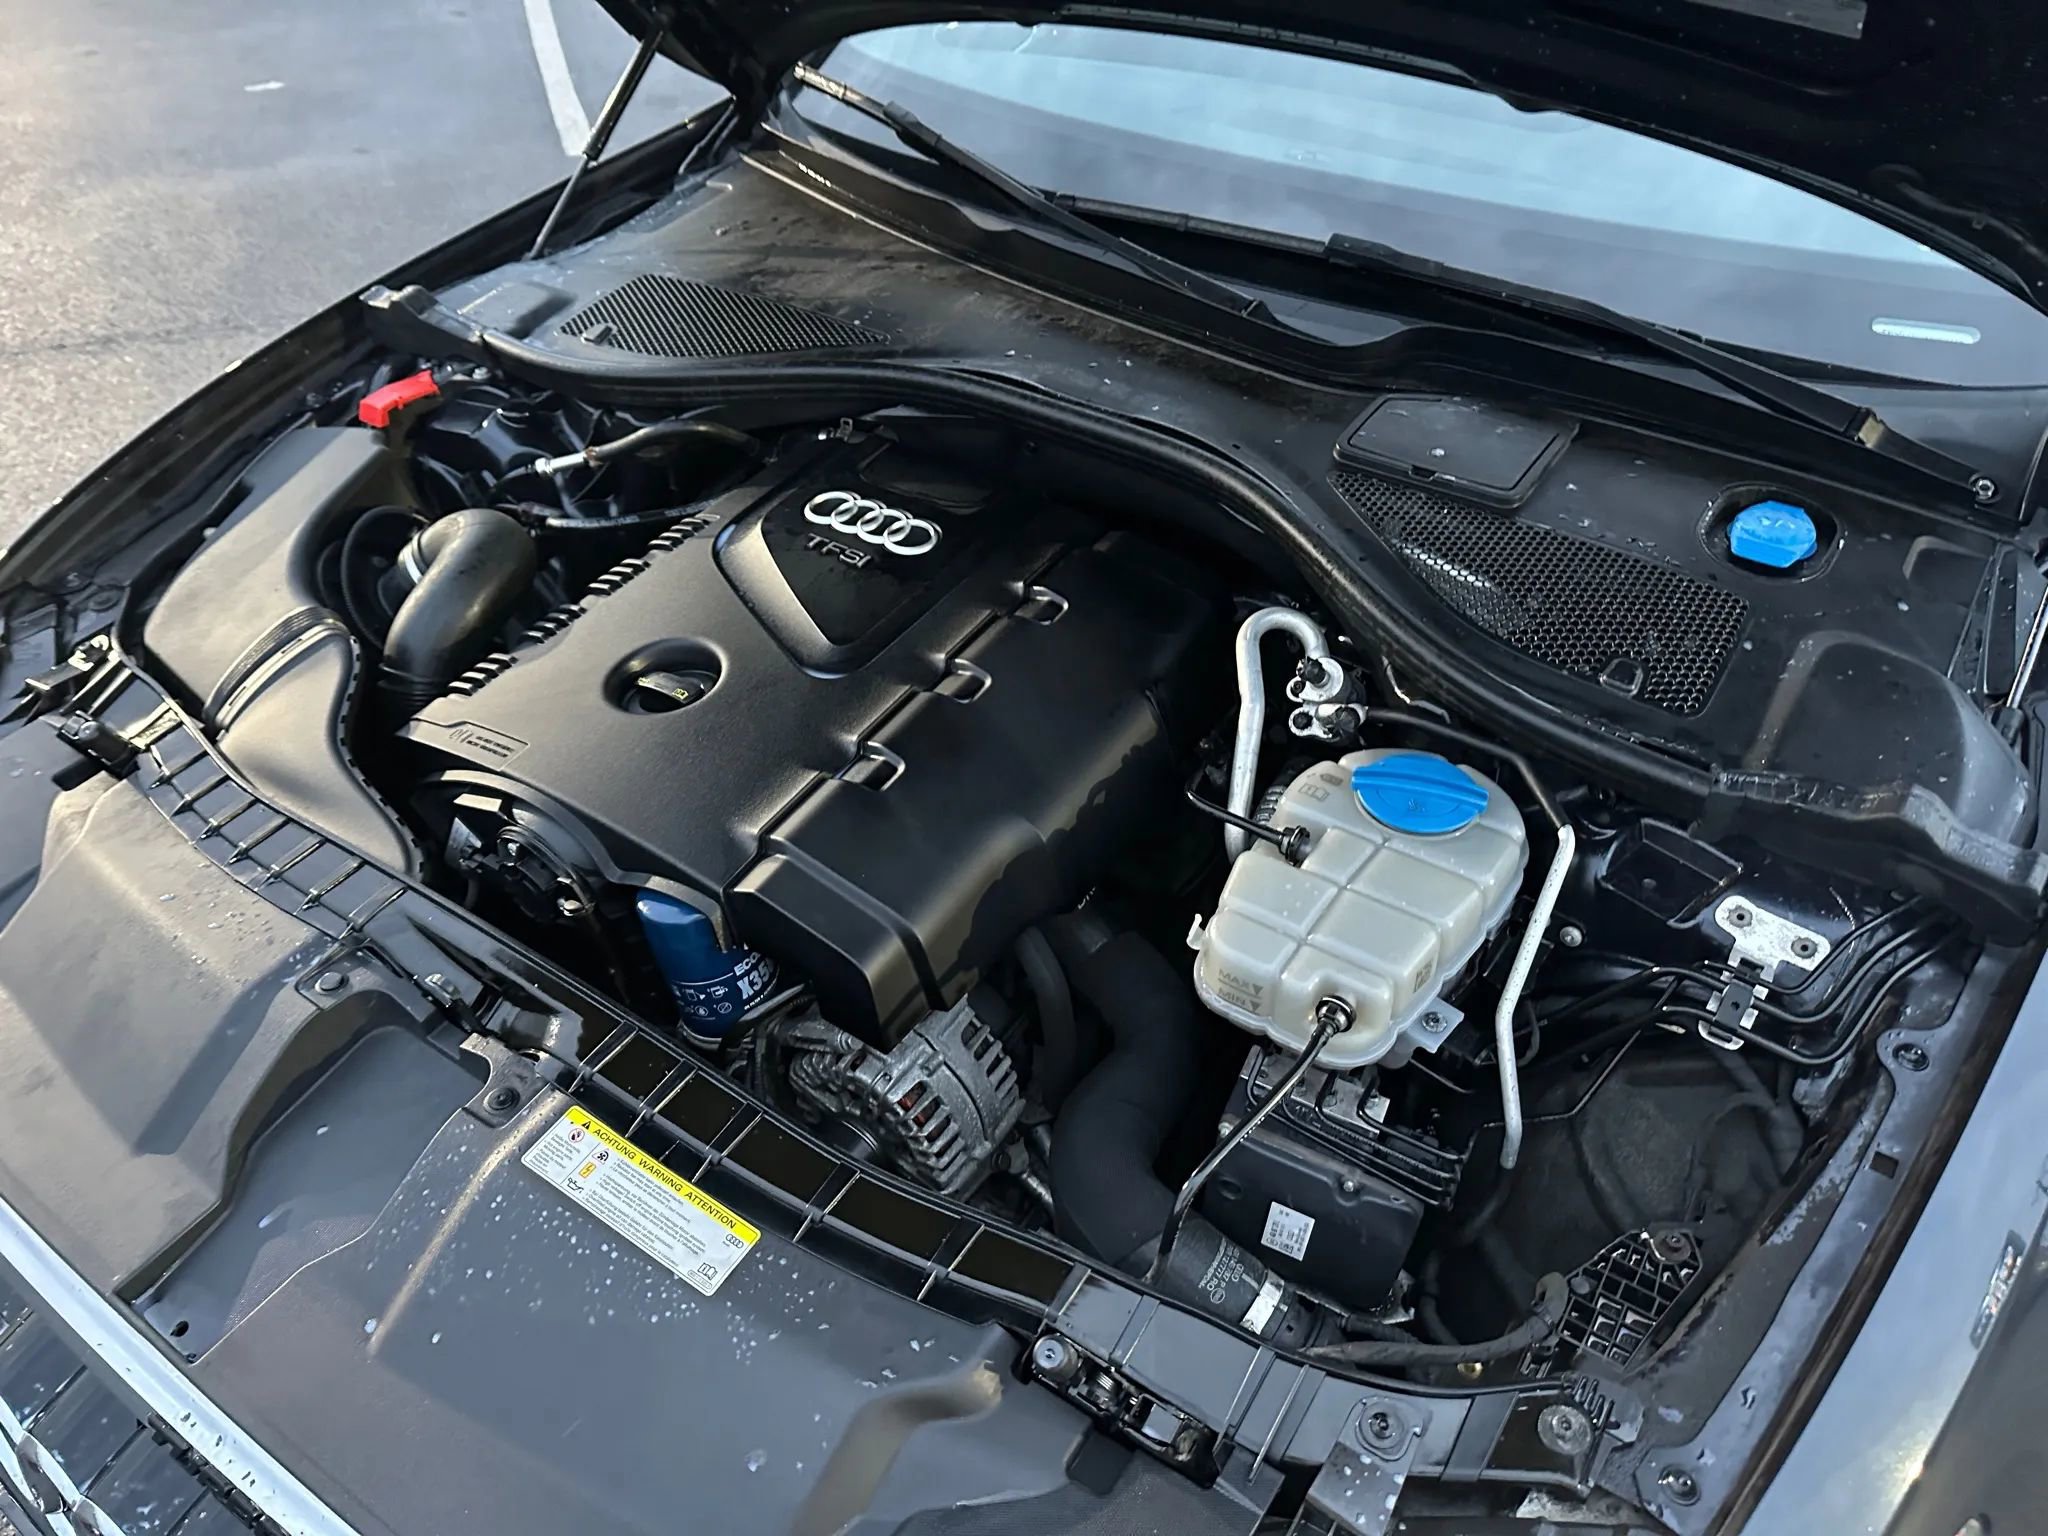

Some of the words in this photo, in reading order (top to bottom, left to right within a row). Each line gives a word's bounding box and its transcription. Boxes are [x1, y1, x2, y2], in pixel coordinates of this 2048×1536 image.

[807, 533, 872, 568] TFSI
[1218, 969, 1250, 990] MAX
[593, 1128, 637, 1160] ACHTUNG
[638, 1157, 684, 1193] WARNING
[685, 1191, 737, 1230] ATTENTION
